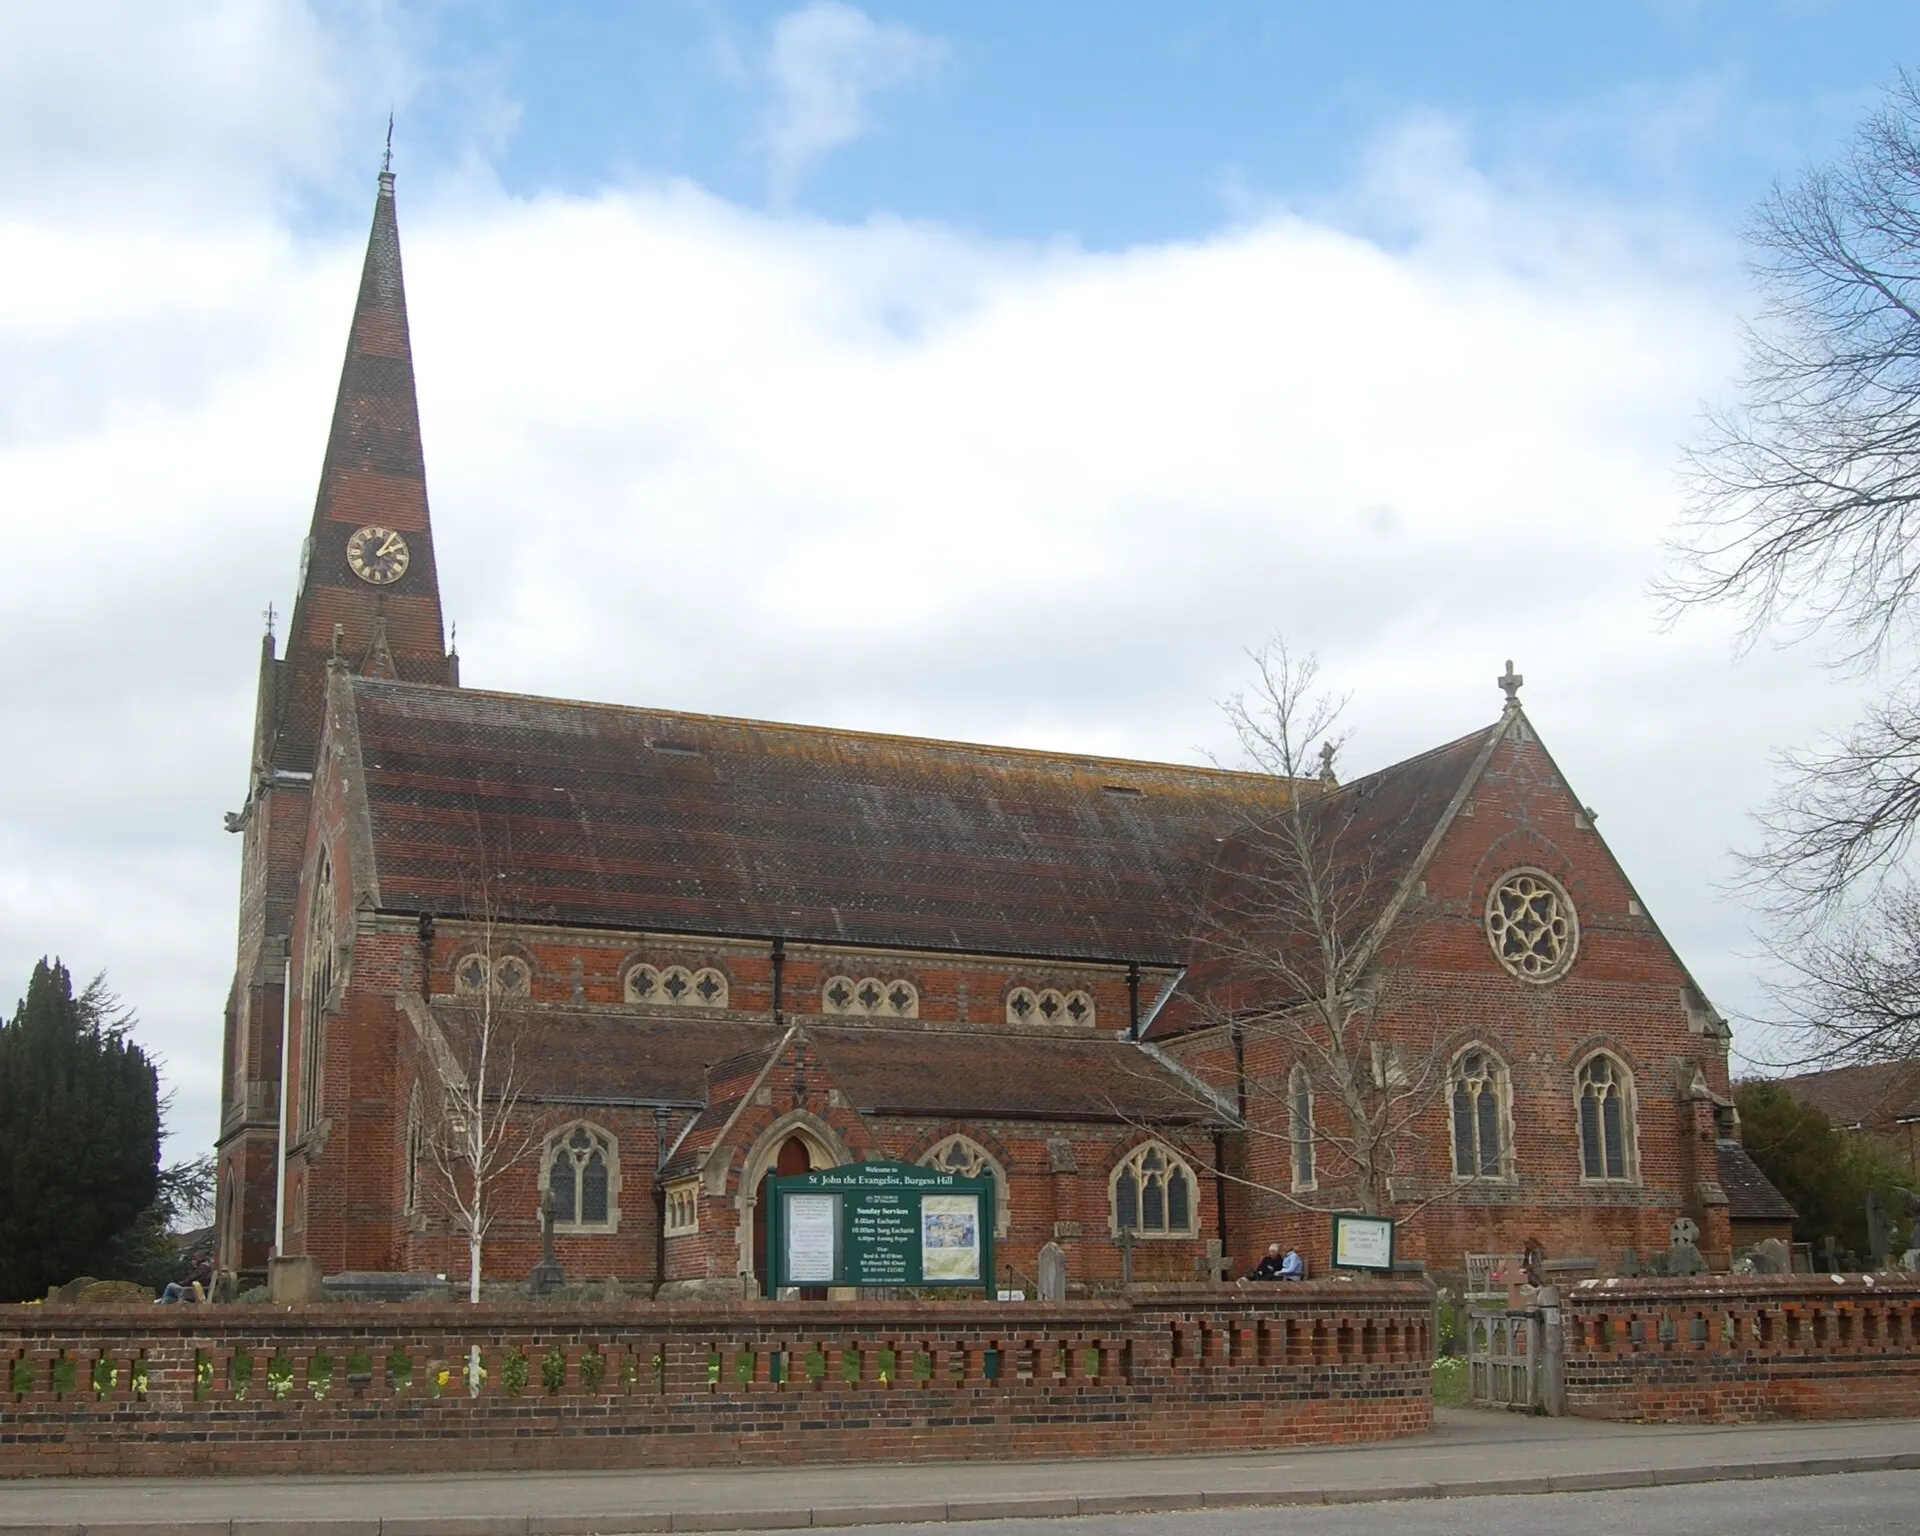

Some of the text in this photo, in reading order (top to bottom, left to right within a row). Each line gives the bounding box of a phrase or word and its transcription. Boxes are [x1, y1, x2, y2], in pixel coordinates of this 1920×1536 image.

[809, 1175, 953, 1186] St John the Evangelist, Burgess Hill
[857, 1207, 881, 1216] Sunday
